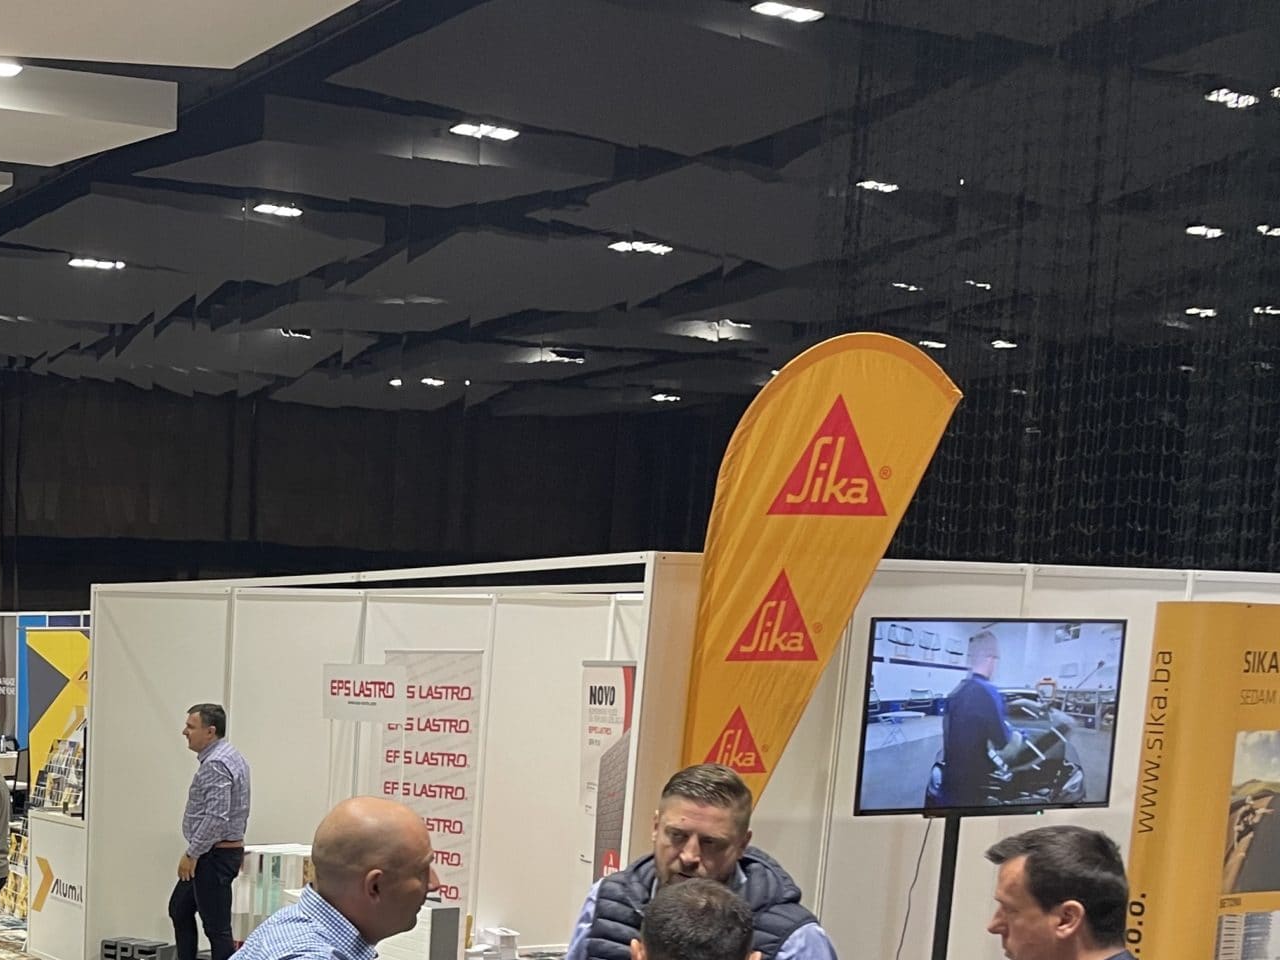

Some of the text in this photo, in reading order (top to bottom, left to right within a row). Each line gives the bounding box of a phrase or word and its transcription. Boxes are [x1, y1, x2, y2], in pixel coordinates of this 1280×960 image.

[786, 436, 868, 504] Sika
[739, 600, 804, 653] Sika
[1243, 651, 1280, 673] SIKA
[330, 679, 351, 697] EPS
[353, 681, 395, 699] LASTRO
[419, 685, 472, 700] LASTRO
[417, 717, 469, 733] LASTRO
[1138, 651, 1173, 833] www.sika.ba
[415, 751, 467, 768] LASTRO
[413, 783, 465, 800] LASTRO
[424, 818, 463, 834] STRO
